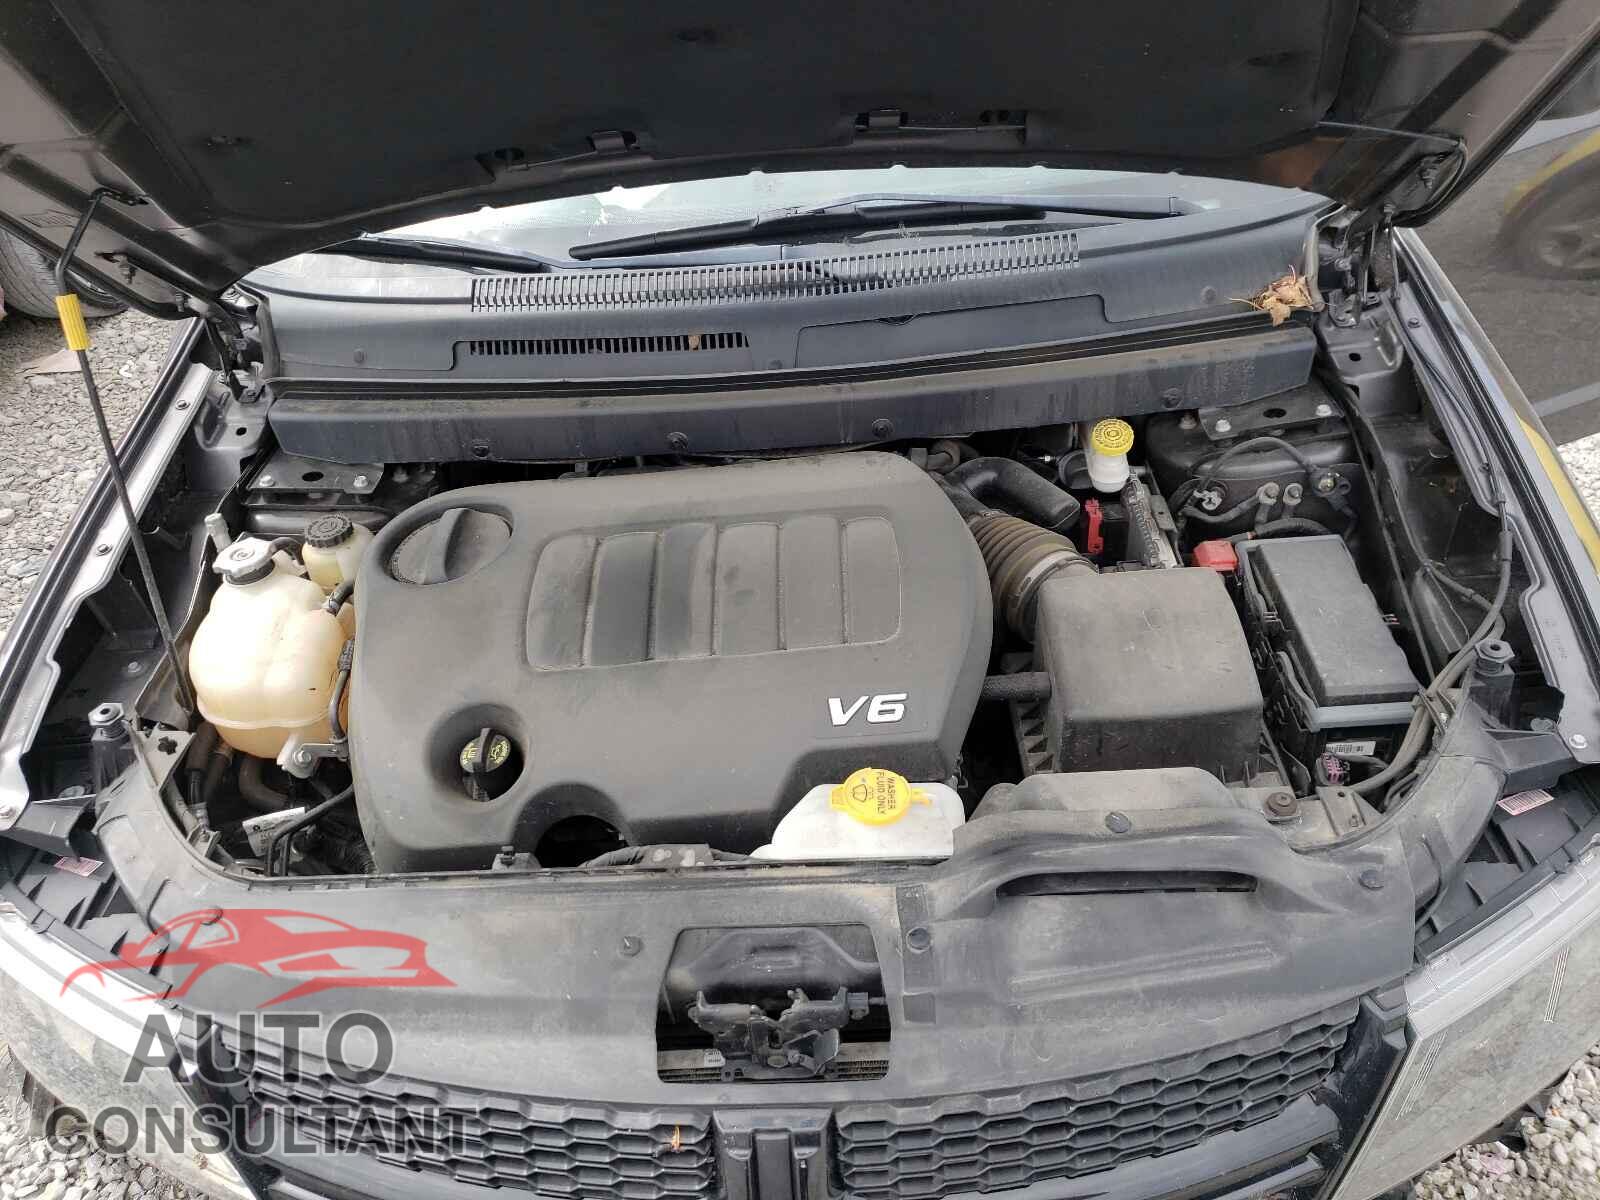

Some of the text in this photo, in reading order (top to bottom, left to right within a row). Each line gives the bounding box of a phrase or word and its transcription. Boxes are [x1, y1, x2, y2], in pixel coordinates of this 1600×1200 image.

[828, 693, 908, 726] V6
[875, 771, 887, 815] FLUID ONLY
[887, 777, 897, 810] WASHER
